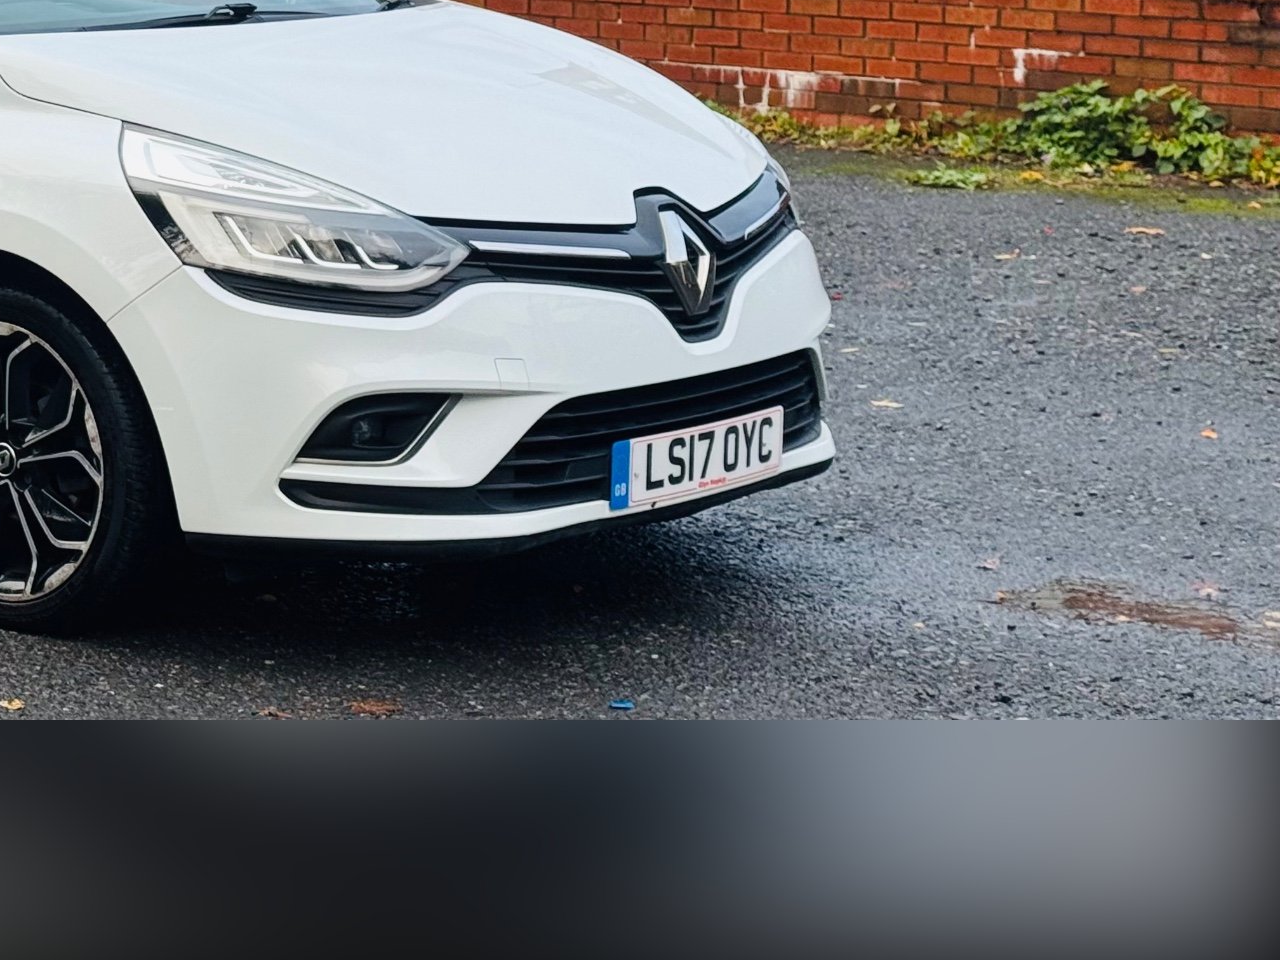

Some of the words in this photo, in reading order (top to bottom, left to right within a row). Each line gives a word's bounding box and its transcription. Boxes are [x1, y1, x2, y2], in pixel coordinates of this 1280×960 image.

[645, 430, 715, 491] LS17
[723, 416, 773, 473] OYC
[615, 482, 626, 496] GB
